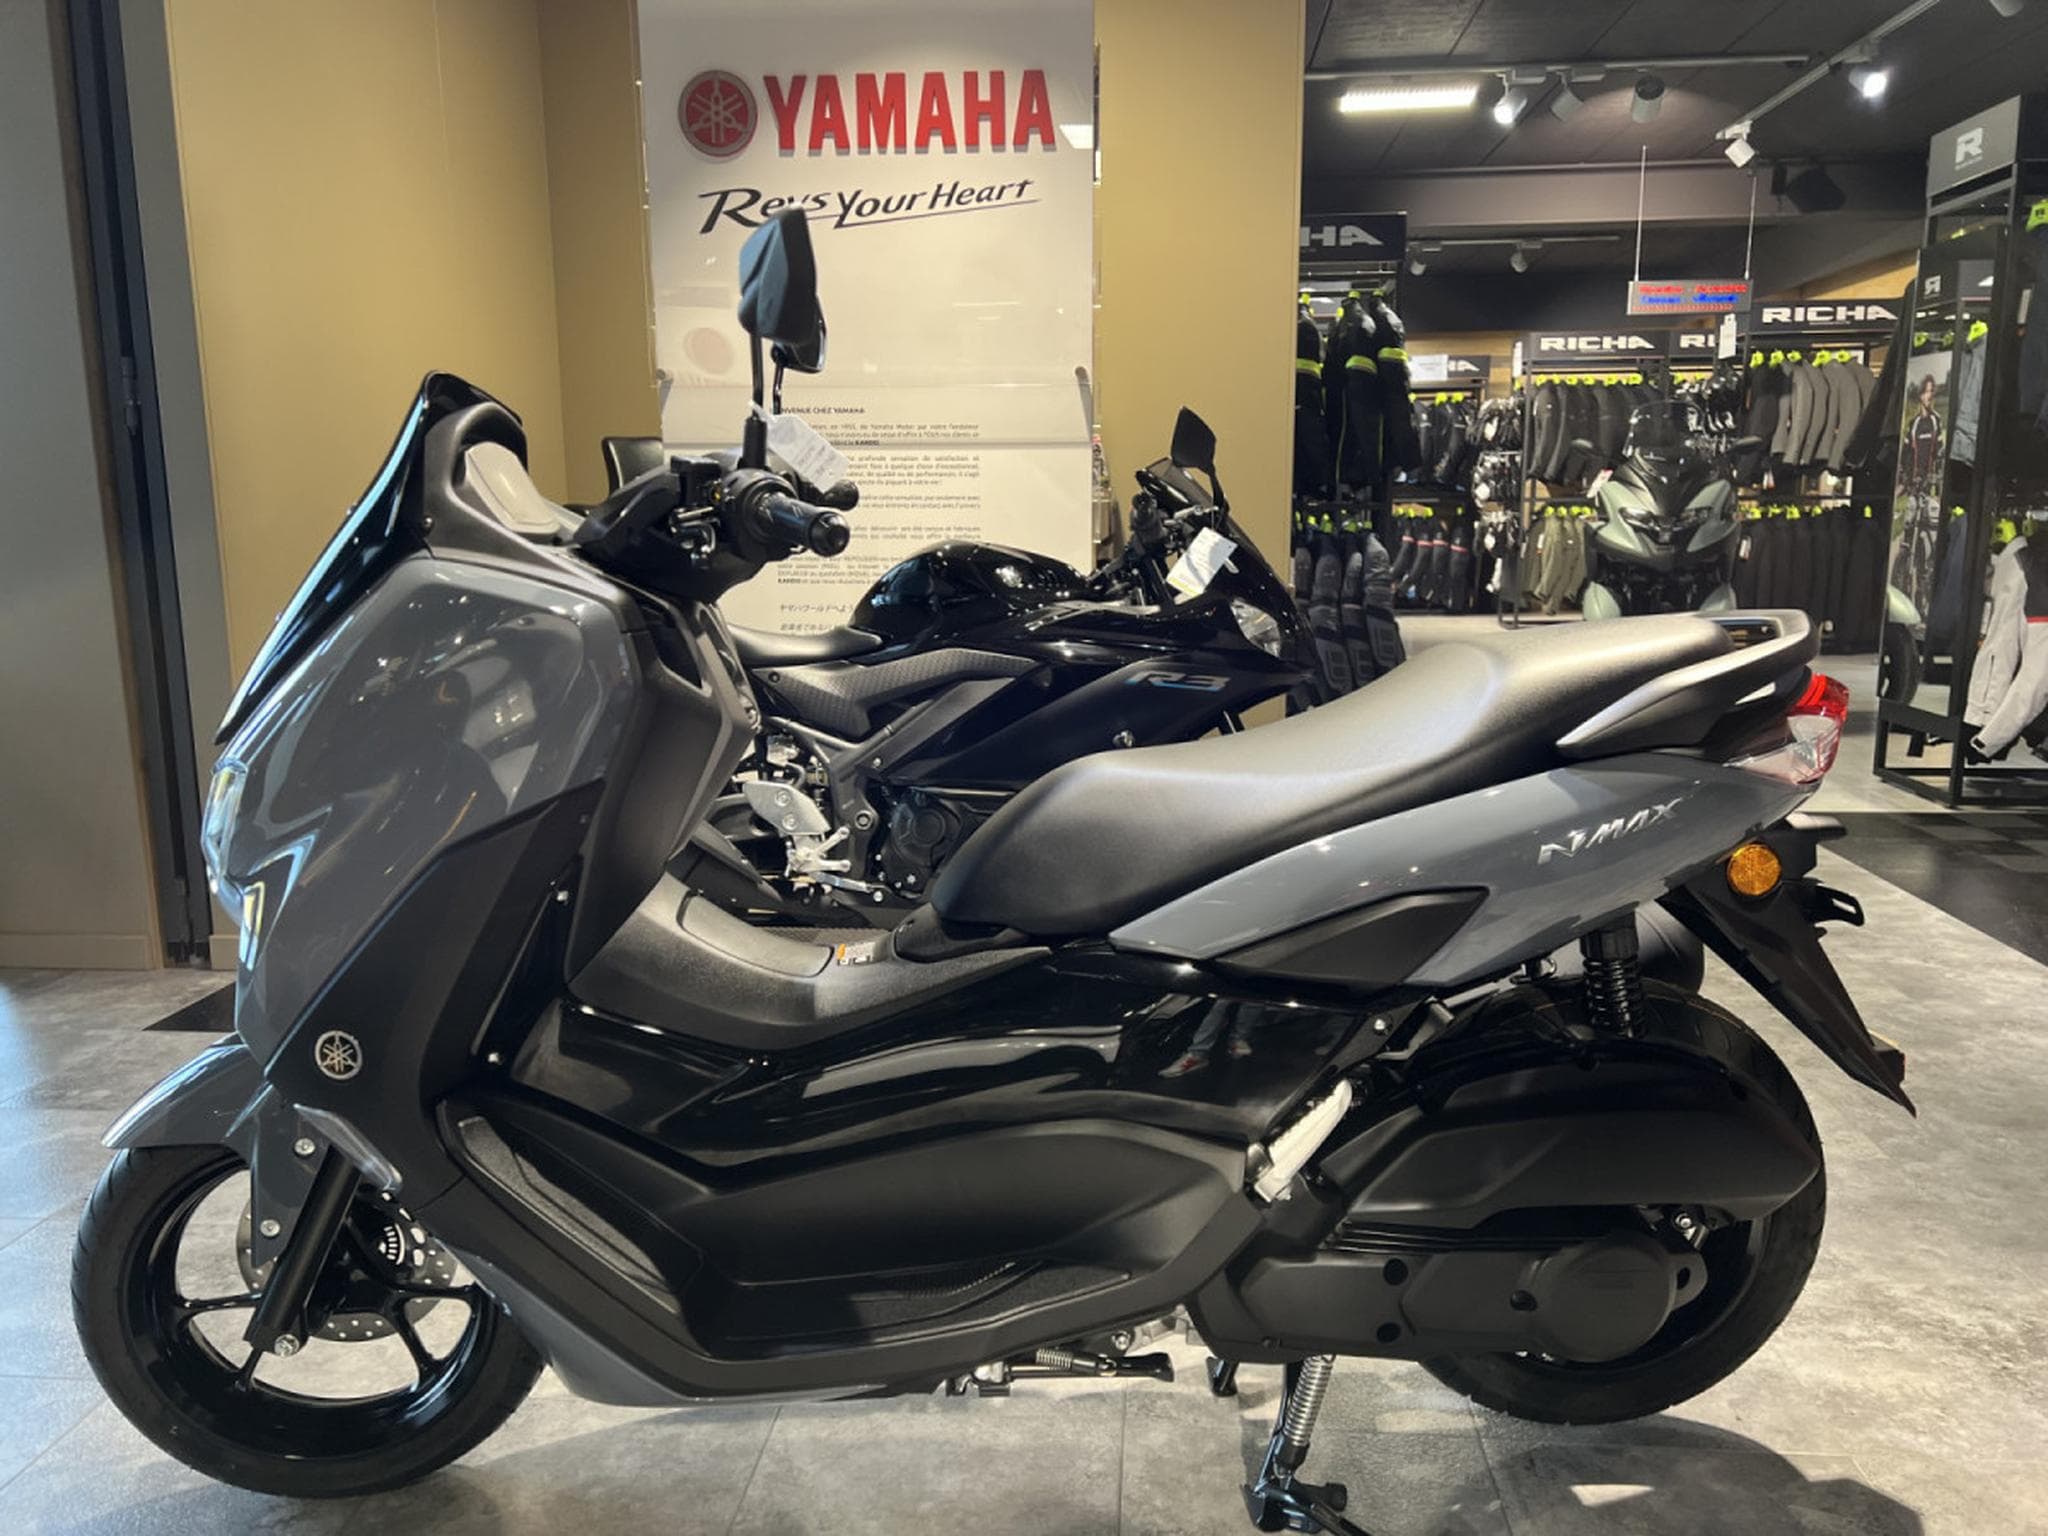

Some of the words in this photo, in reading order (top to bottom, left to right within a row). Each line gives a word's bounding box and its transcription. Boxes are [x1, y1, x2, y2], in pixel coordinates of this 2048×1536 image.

[762, 69, 1057, 157] YAMAHA
[1955, 127, 1984, 164] R
[834, 190, 927, 229] Your
[928, 179, 1036, 210] Heart
[1762, 305, 1899, 323] RICHA
[1540, 336, 1655, 351] RICHA
[1537, 797, 1684, 866] NMAX
